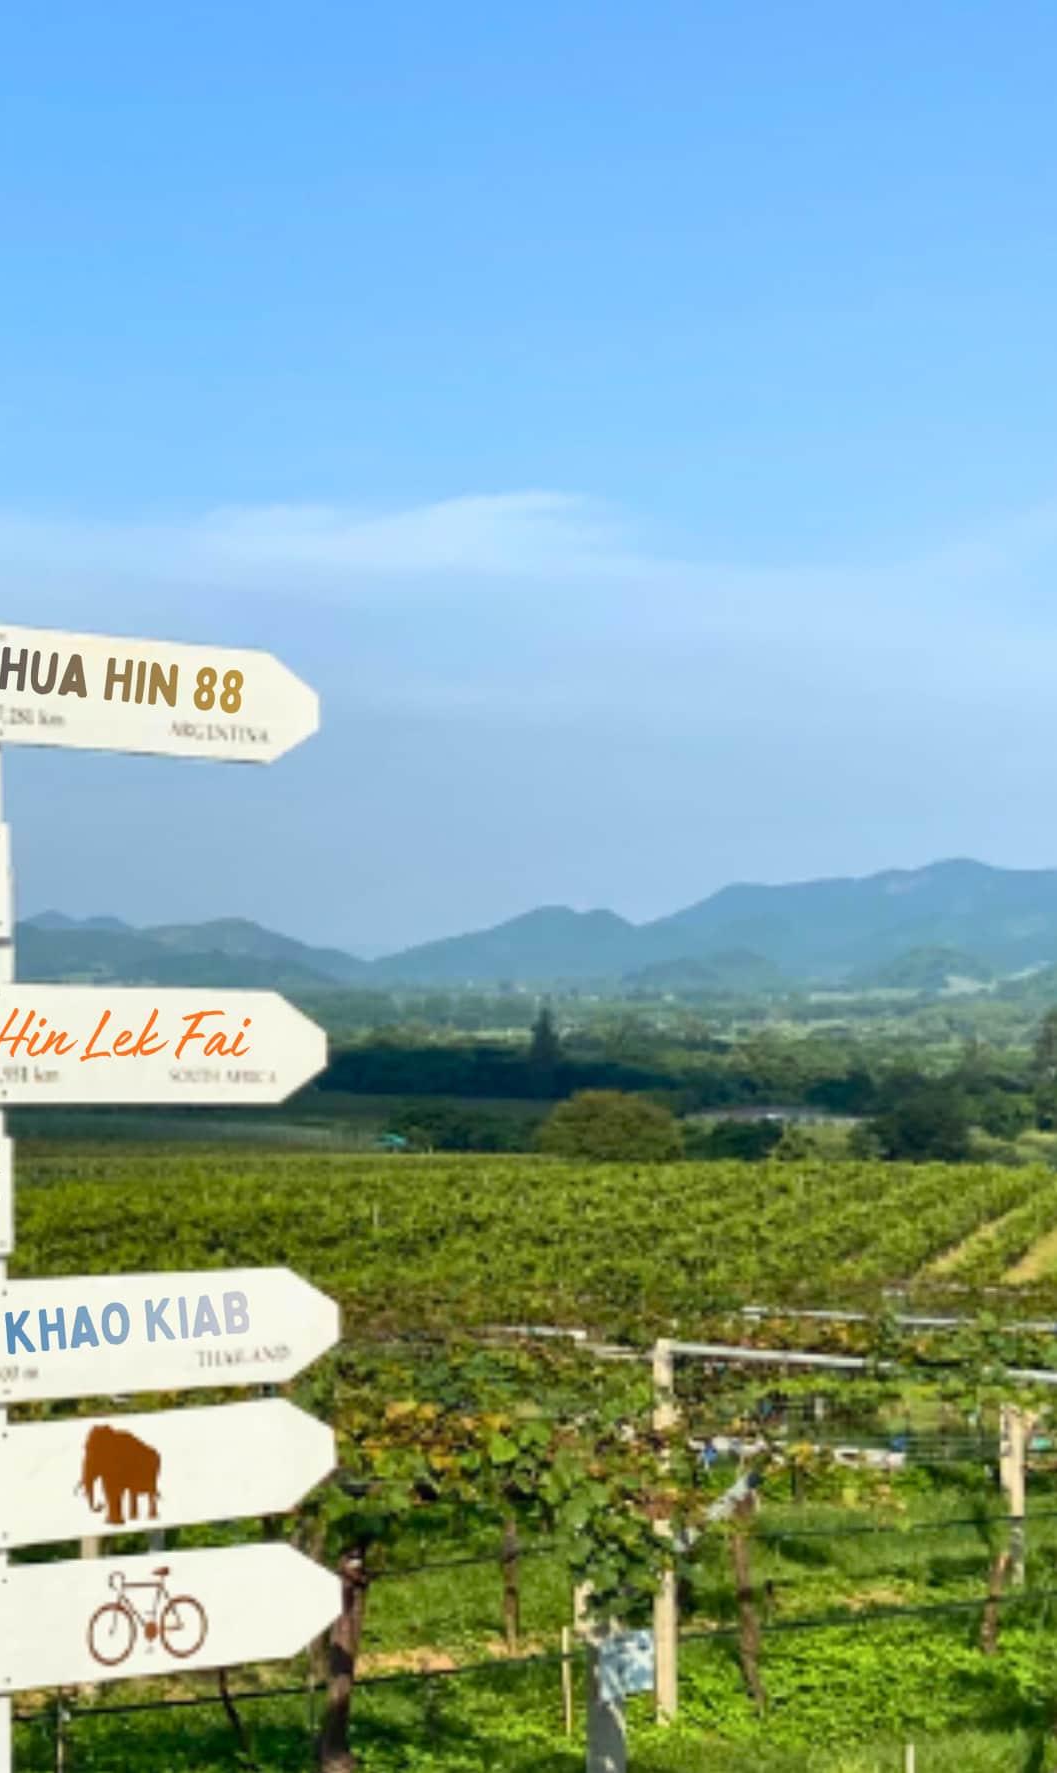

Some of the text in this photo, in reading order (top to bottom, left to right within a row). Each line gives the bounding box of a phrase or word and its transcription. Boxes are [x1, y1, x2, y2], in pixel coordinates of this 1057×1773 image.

[103, 657, 179, 708] HIN
[193, 666, 244, 714] 88
[79, 1007, 170, 1062] Lek
[174, 1010, 252, 1060] Fai
[5, 1291, 250, 1355] KHAO KIAB
